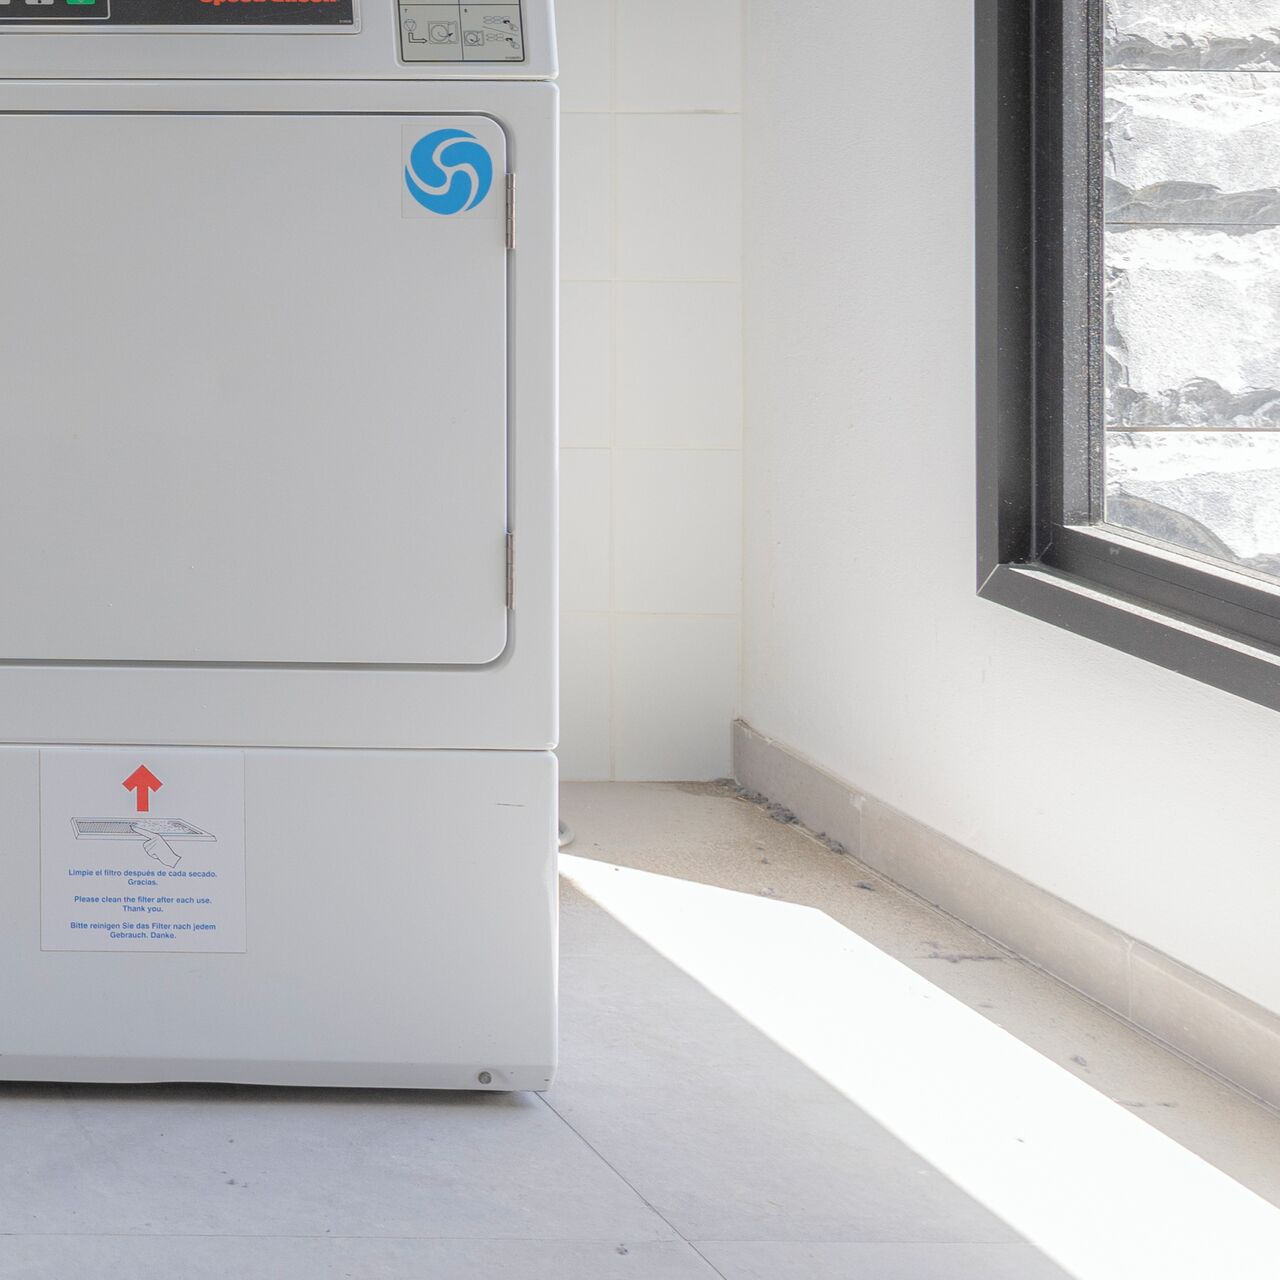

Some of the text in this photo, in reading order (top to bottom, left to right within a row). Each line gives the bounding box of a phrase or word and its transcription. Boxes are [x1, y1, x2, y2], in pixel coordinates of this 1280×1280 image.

[68, 869, 93, 877] Limpie
[123, 869, 155, 877] después
[74, 895, 99, 903] Please
[101, 895, 121, 903] clean
[123, 895, 135, 903] the
[137, 895, 155, 903] filter
[175, 896, 194, 904] each
[90, 922, 120, 931] reinigen
[152, 922, 171, 930] Filter
[193, 923, 216, 931] jedem
[110, 931, 176, 939] Gebrauch. Danke.
